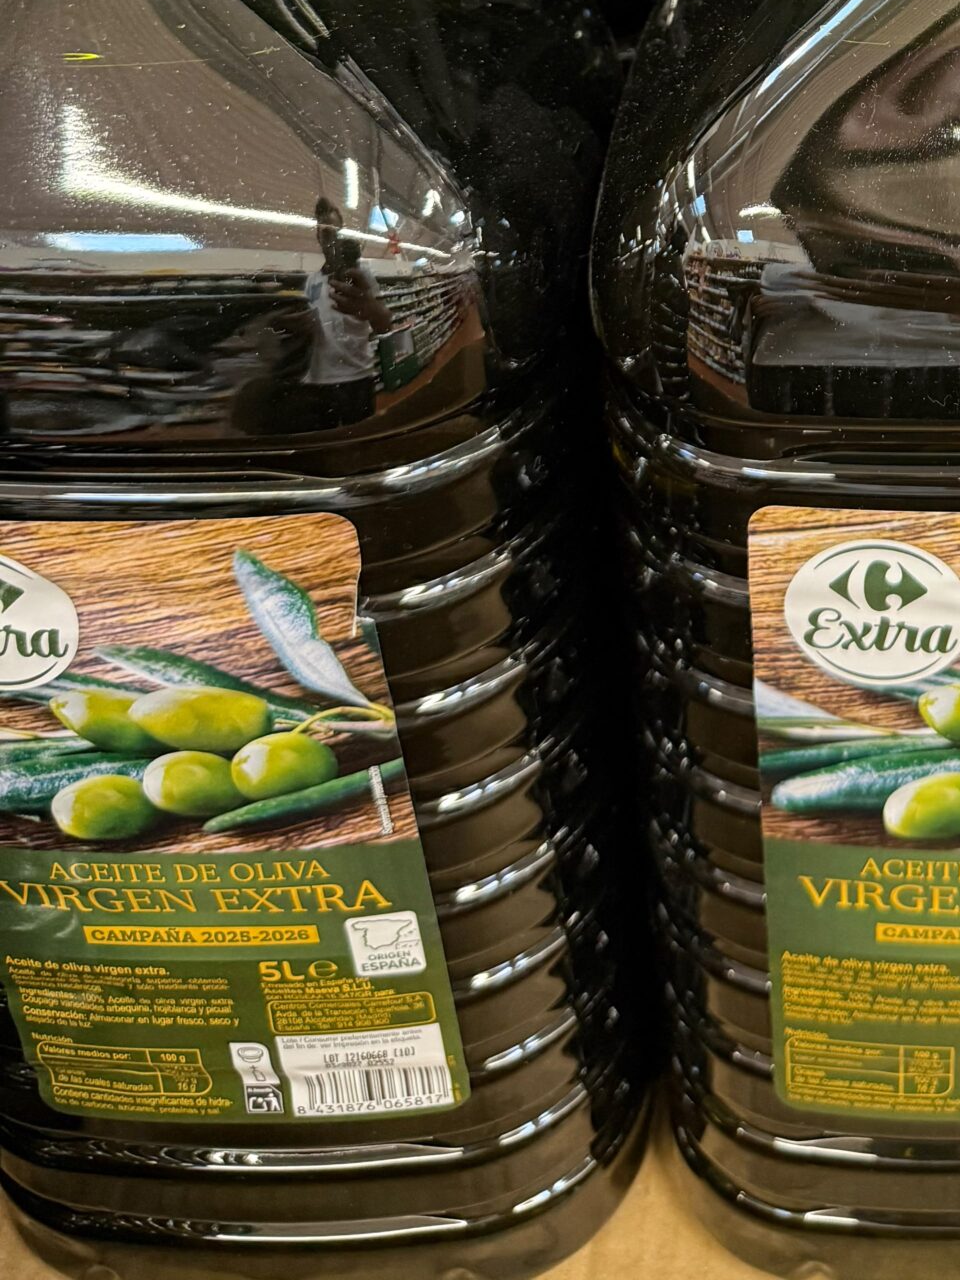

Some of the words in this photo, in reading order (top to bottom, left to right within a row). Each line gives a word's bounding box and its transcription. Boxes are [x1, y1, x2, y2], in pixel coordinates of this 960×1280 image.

[803, 607, 958, 655] Extra
[49, 861, 164, 883] ACEITE
[174, 863, 221, 884] DE
[229, 859, 331, 883] OLIVA
[0, 880, 201, 913] VIRGEN
[209, 879, 393, 913] EXTRA
[91, 926, 197, 943] CAMPAÑA
[202, 928, 311, 944] 2025-2026
[5, 954, 42, 968] Aceite
[44, 960, 59, 970] de
[62, 962, 91, 973] oliva
[93, 963, 132, 975] virgen
[134, 965, 170, 976] extra.
[361, 956, 422, 971] ESPAÑA
[367, 950, 411, 961] ORIGEN
[258, 960, 305, 982] 5L
[22, 1005, 87, 1021] Conservación:
[160, 1053, 176, 1062] 100
[323, 1054, 340, 1063] LOT
[297, 1106, 306, 1115] 8
[315, 1102, 376, 1114] 431876
[383, 1094, 443, 1110] 065817
